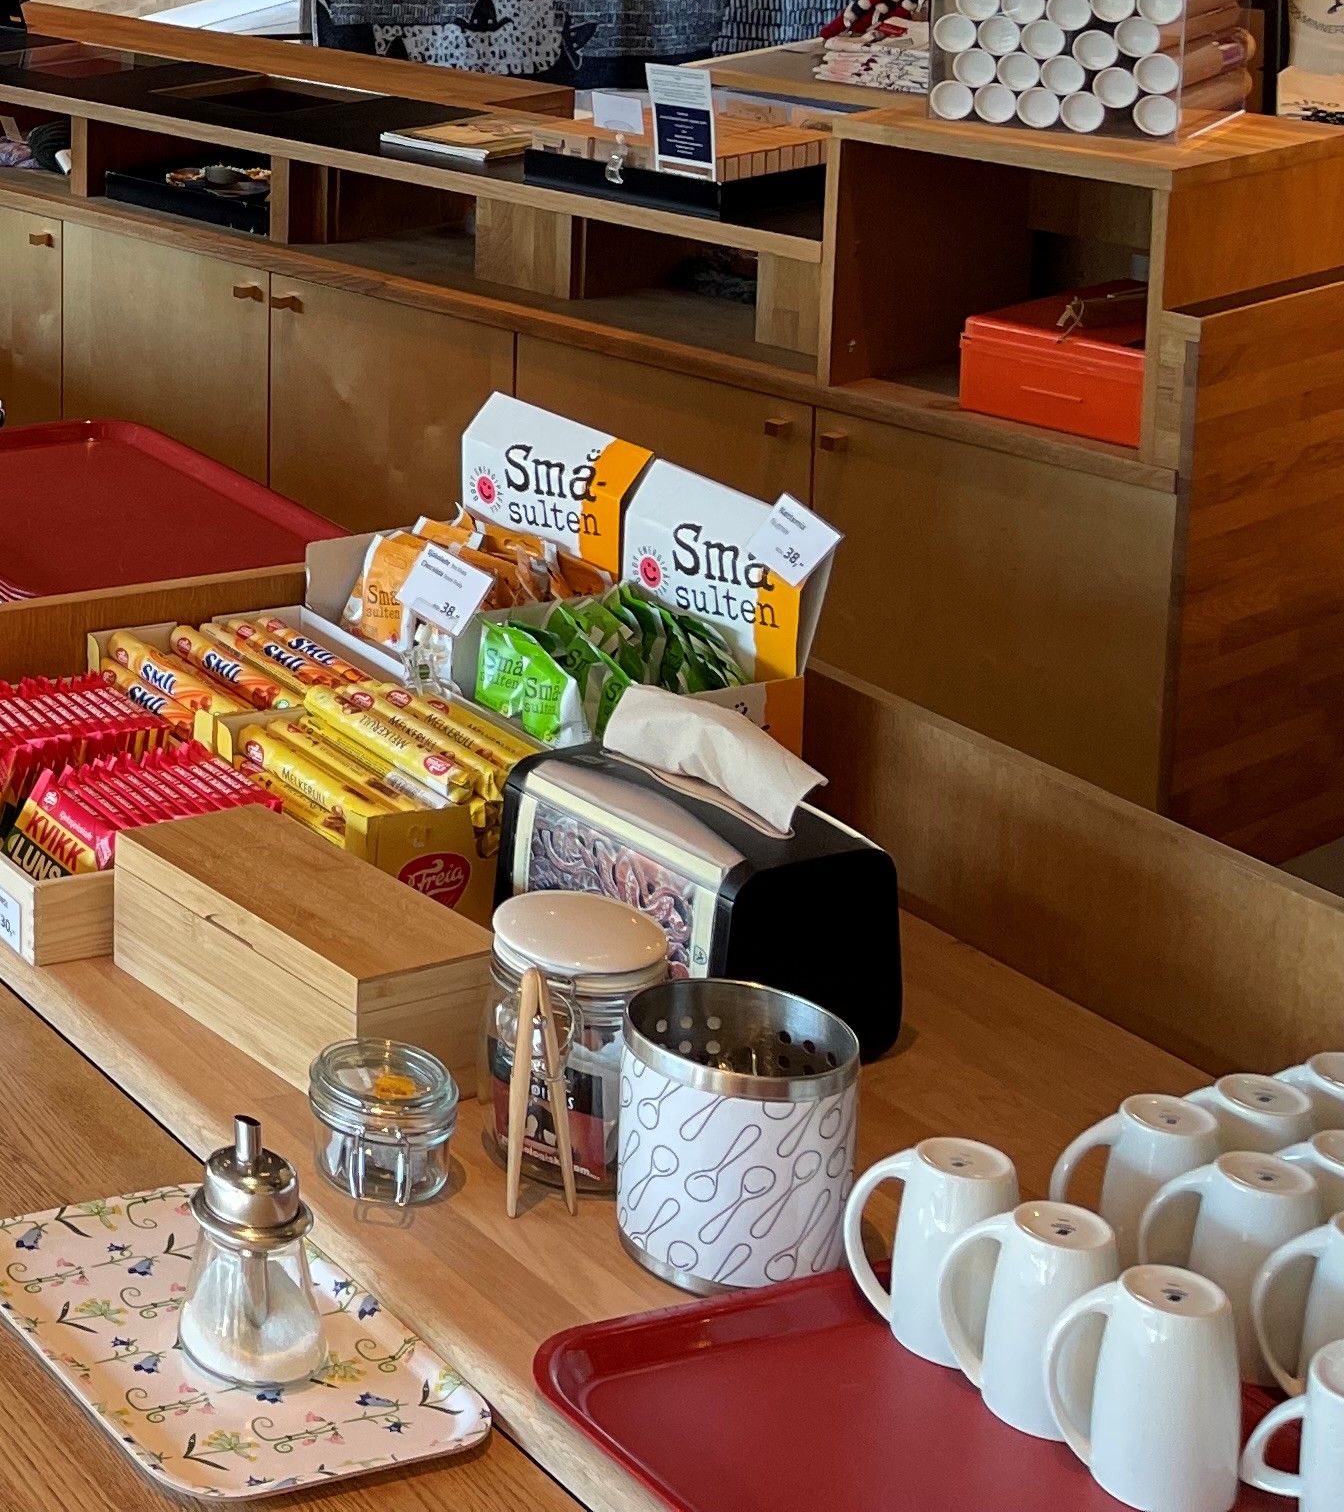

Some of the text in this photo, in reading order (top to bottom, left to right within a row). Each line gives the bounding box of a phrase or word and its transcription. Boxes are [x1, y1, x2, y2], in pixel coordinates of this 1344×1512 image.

[508, 499, 601, 536] sulten
[365, 606, 400, 620] sulten
[675, 585, 780, 629] sulten
[388, 715, 439, 752] MELKERULL
[426, 713, 474, 751] MELKERULL
[281, 766, 329, 808] MELKERULL
[14, 834, 63, 881] LUNS
[24, 809, 88, 874] KVIKK
[408, 859, 464, 890] Freia
